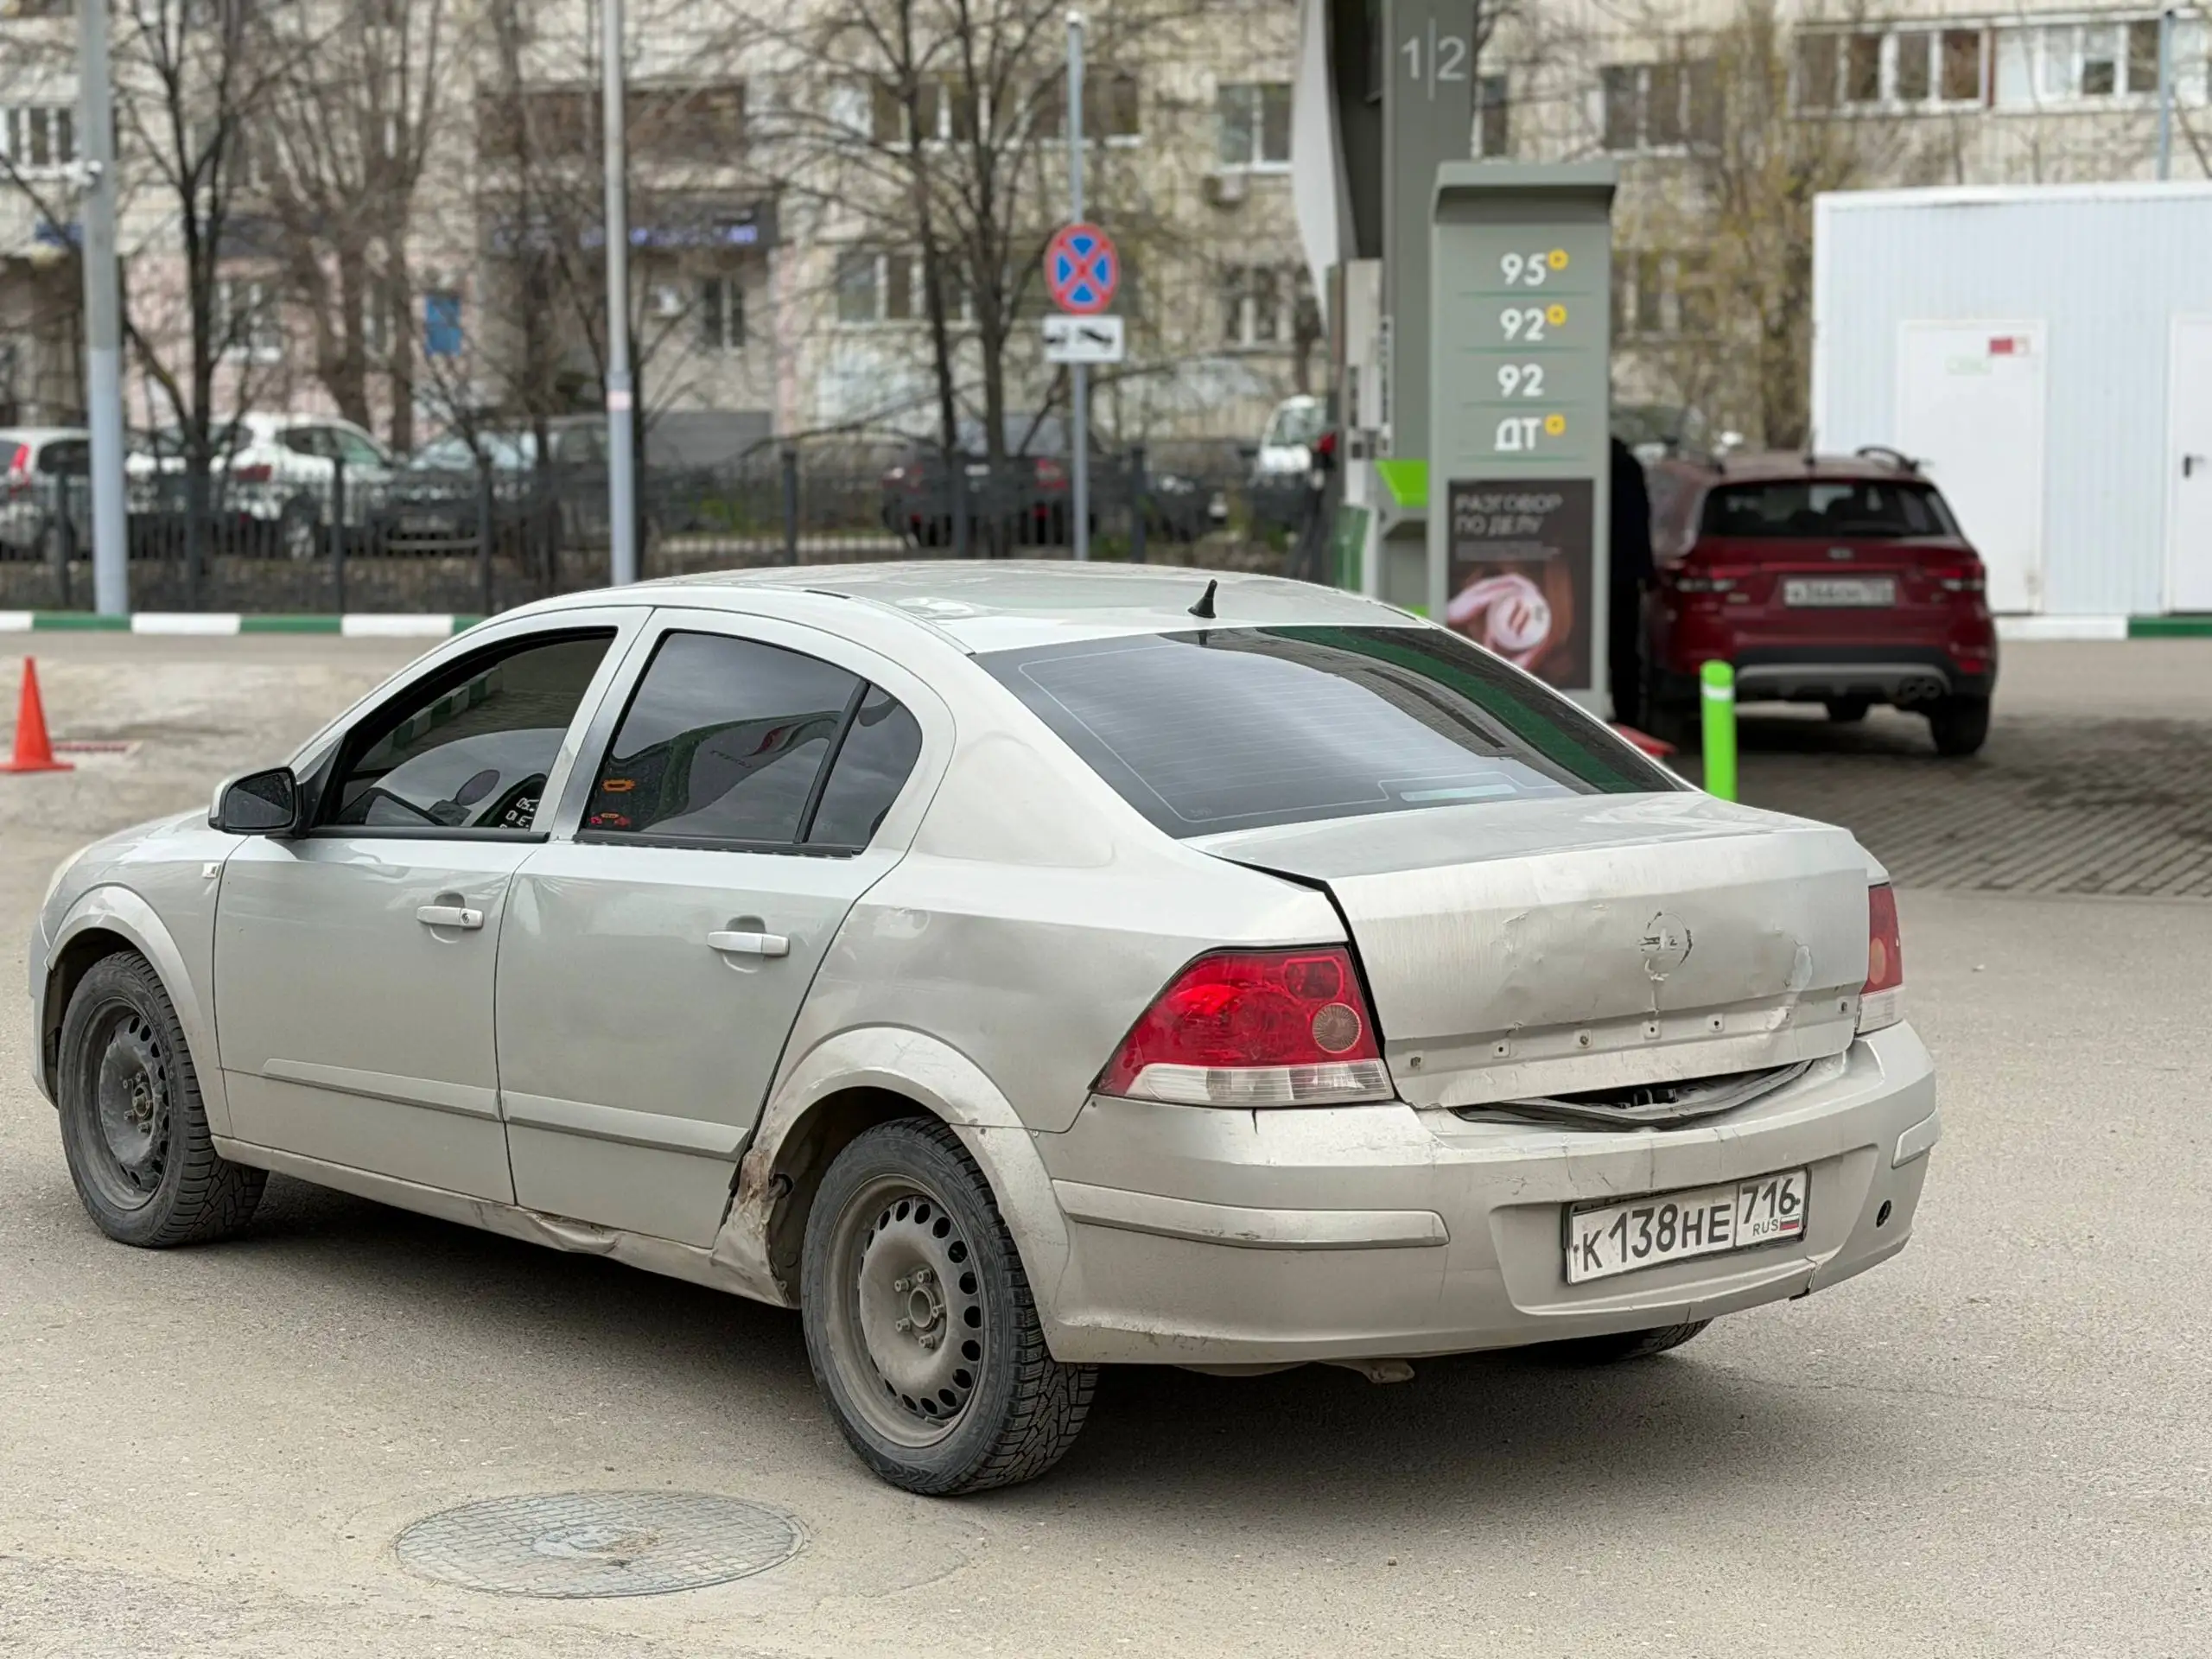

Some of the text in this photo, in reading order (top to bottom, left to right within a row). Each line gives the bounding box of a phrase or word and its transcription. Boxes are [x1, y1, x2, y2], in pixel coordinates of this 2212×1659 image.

[1500, 252, 1546, 286] 95
[1499, 308, 1545, 341] 92
[1497, 363, 1544, 397] 92
[1494, 417, 1541, 451] ДТ
[1742, 1178, 1797, 1225] 716
[1752, 1218, 1779, 1236] RUS
